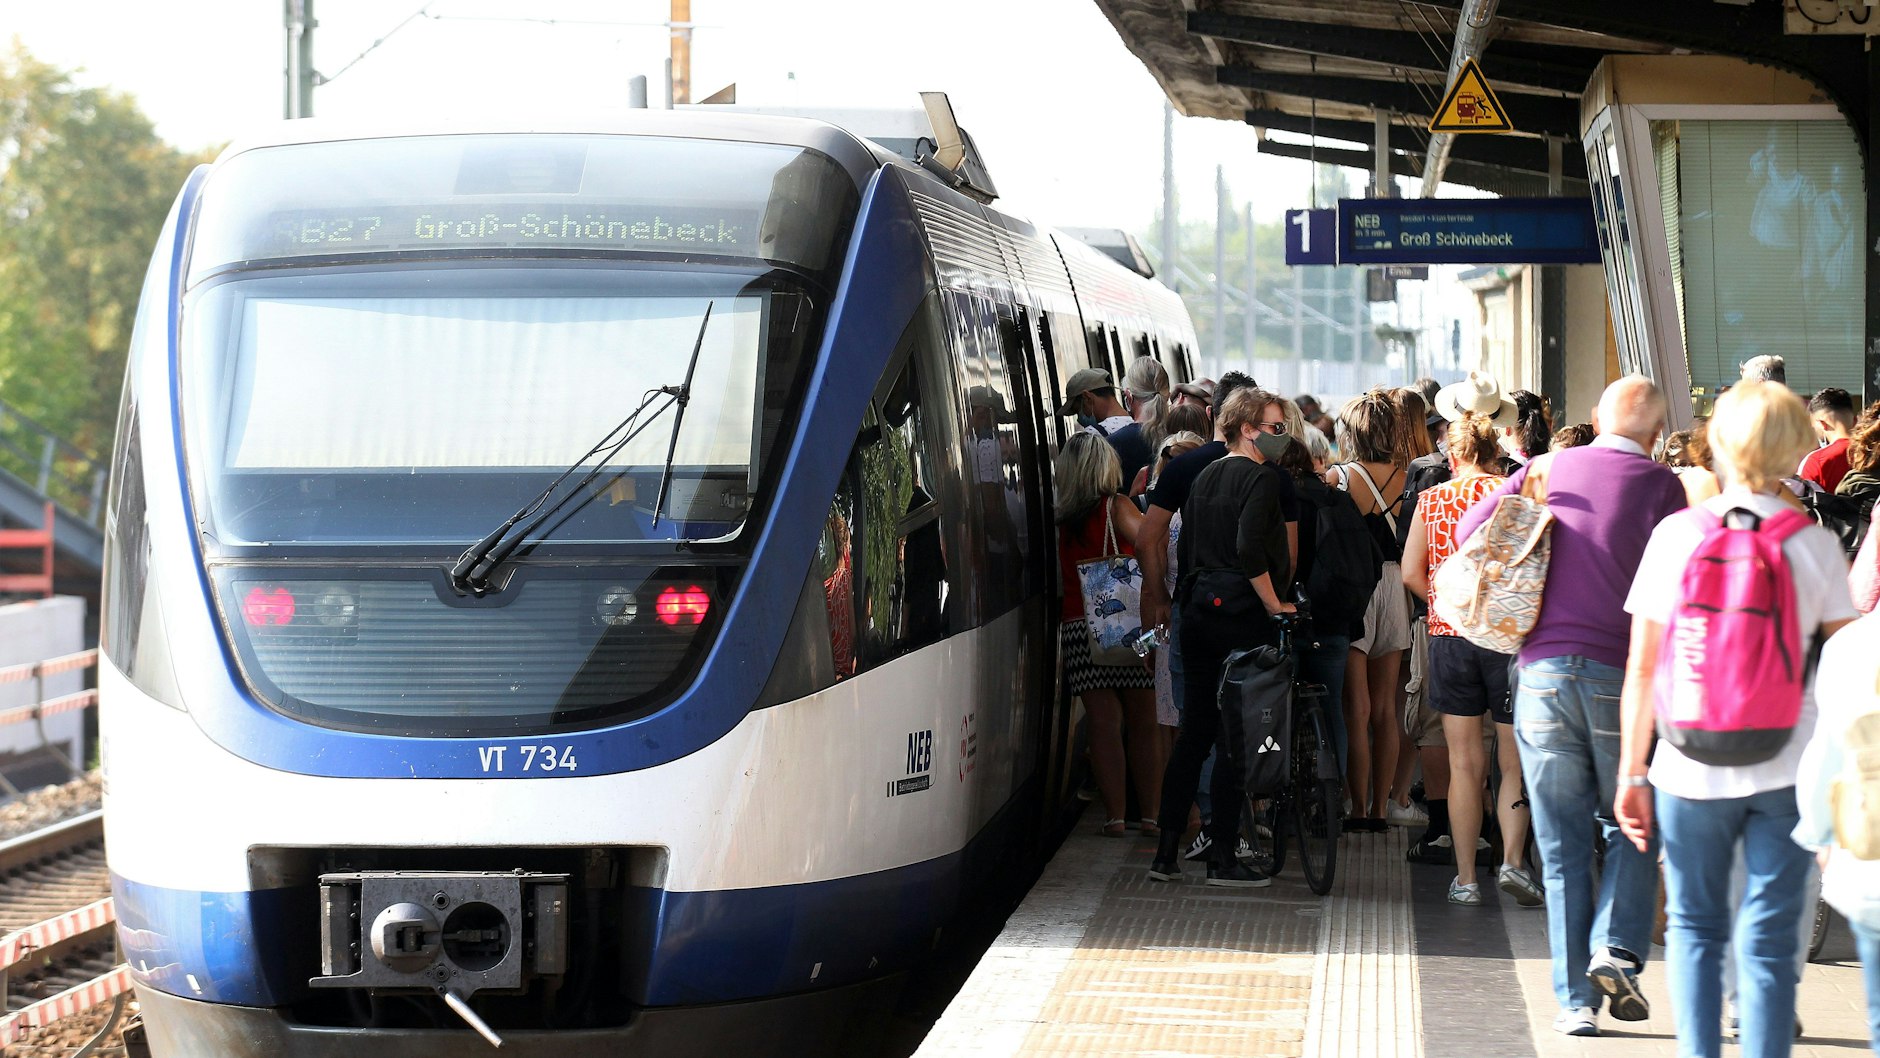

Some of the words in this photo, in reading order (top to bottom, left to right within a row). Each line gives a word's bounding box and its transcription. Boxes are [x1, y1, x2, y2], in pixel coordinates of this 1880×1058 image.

[415, 213, 738, 244] Groß-Schönebeck
[1292, 210, 1311, 253] 1
[1355, 214, 1380, 228] NEB
[1400, 231, 1431, 246] Groß
[1436, 231, 1513, 246] Schönebeck
[1673, 616, 1708, 682] PUMA
[478, 745, 507, 772] VT
[520, 745, 578, 771] 734
[907, 729, 932, 774] NEB
